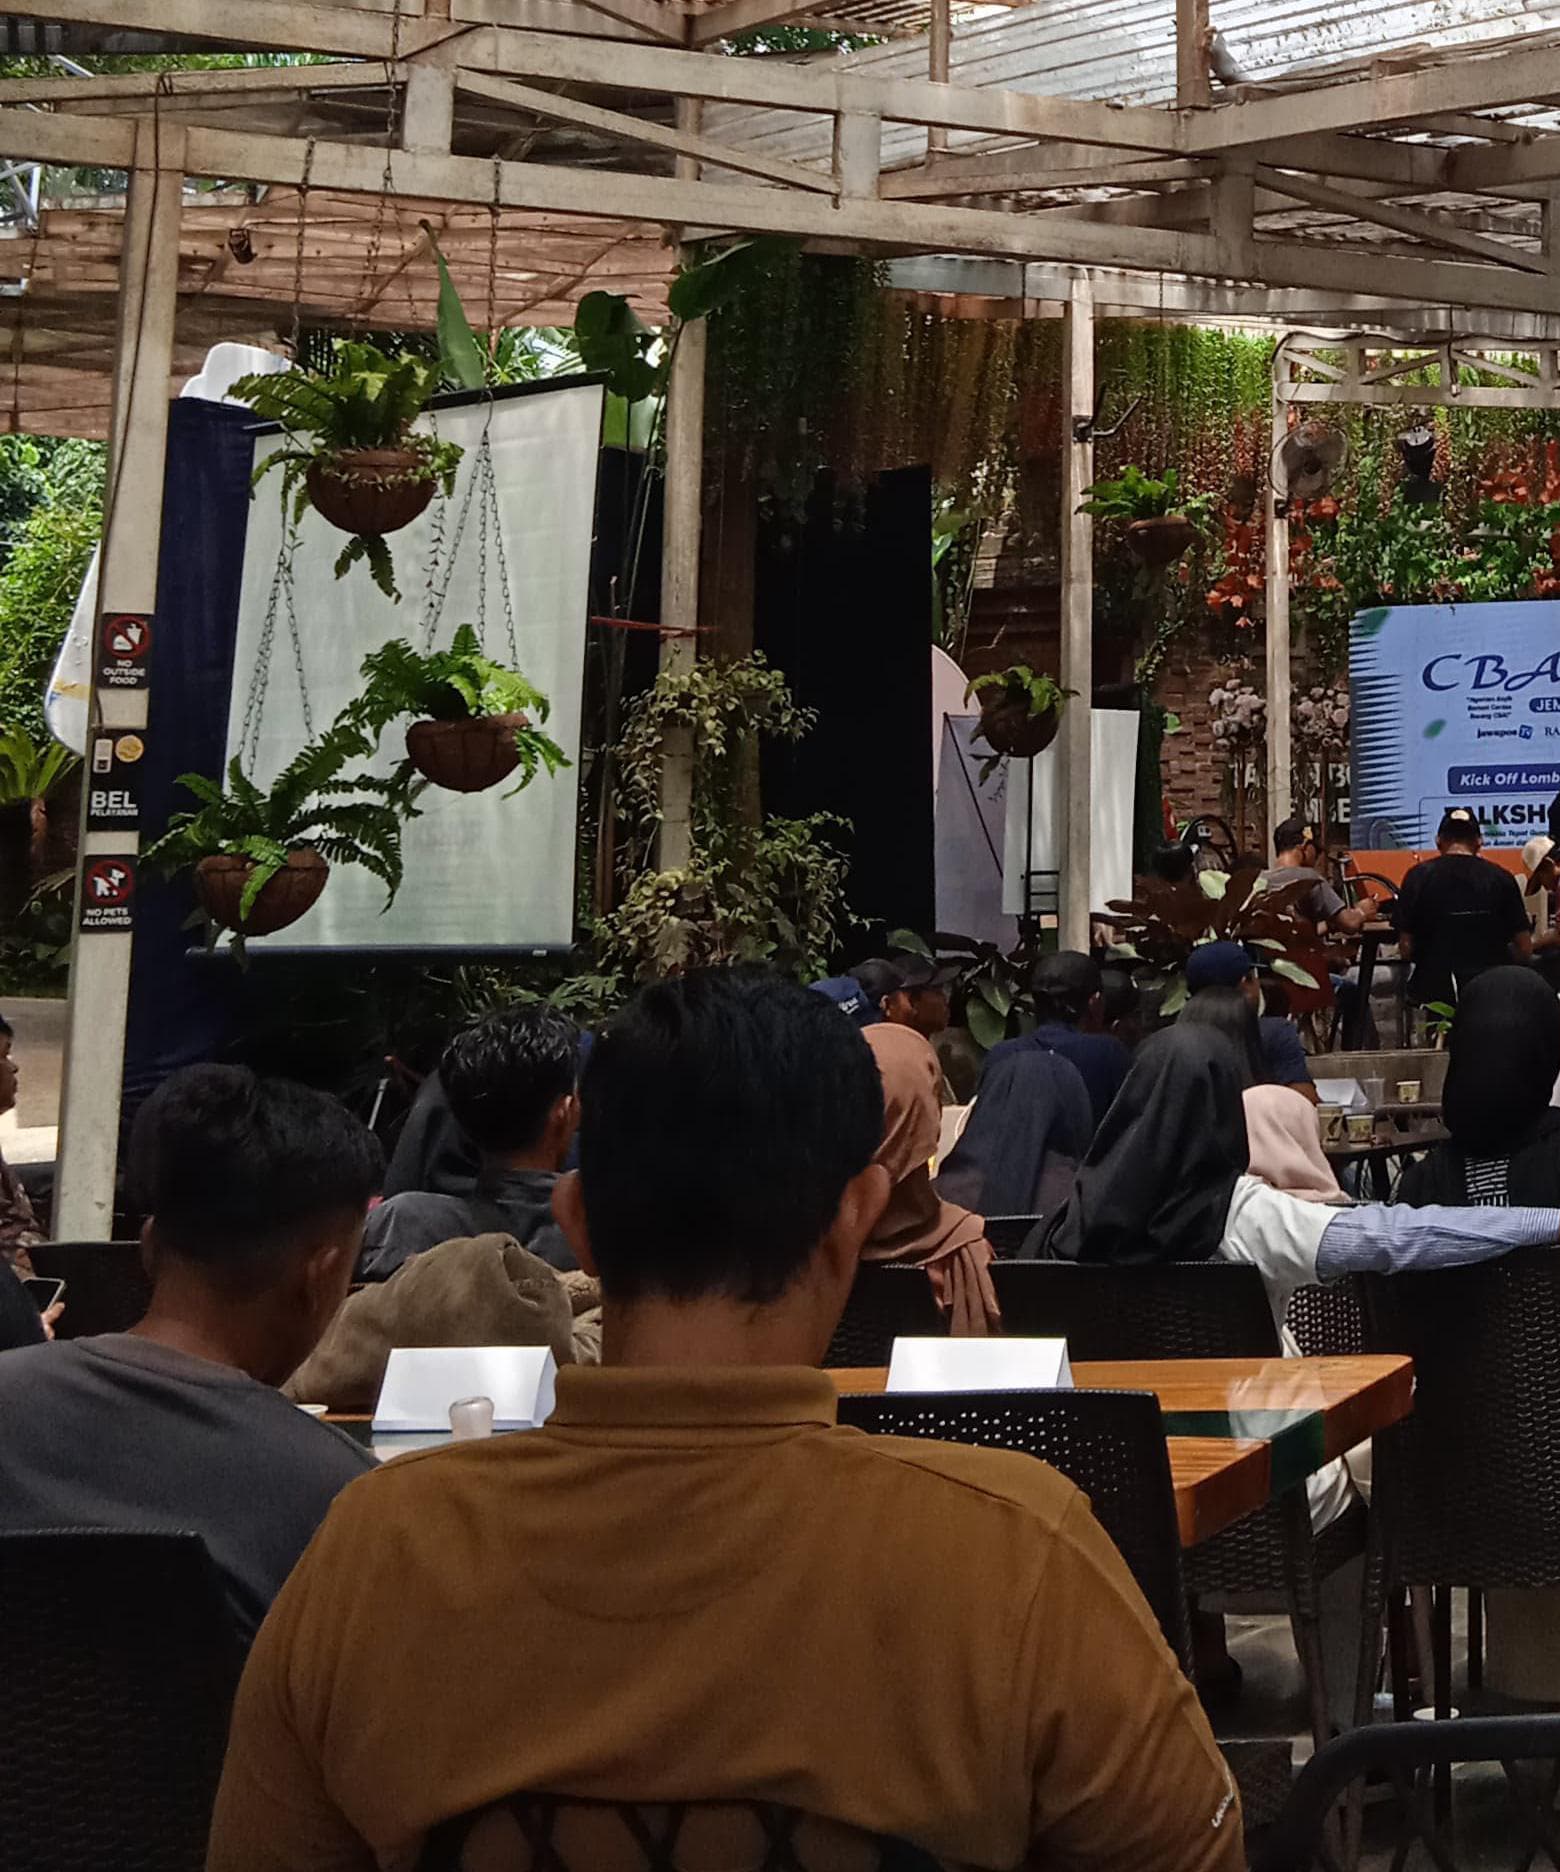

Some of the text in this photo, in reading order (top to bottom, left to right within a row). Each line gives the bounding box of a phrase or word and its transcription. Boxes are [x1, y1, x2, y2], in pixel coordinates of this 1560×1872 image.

[102, 667, 146, 676] OUTSIDE
[109, 676, 138, 685] FOOD
[1460, 773, 1491, 786] Kick
[1494, 772, 1518, 785] Off
[91, 790, 137, 808] BEL
[86, 907, 129, 917] NO PETS
[81, 916, 132, 926] ALLOWED
